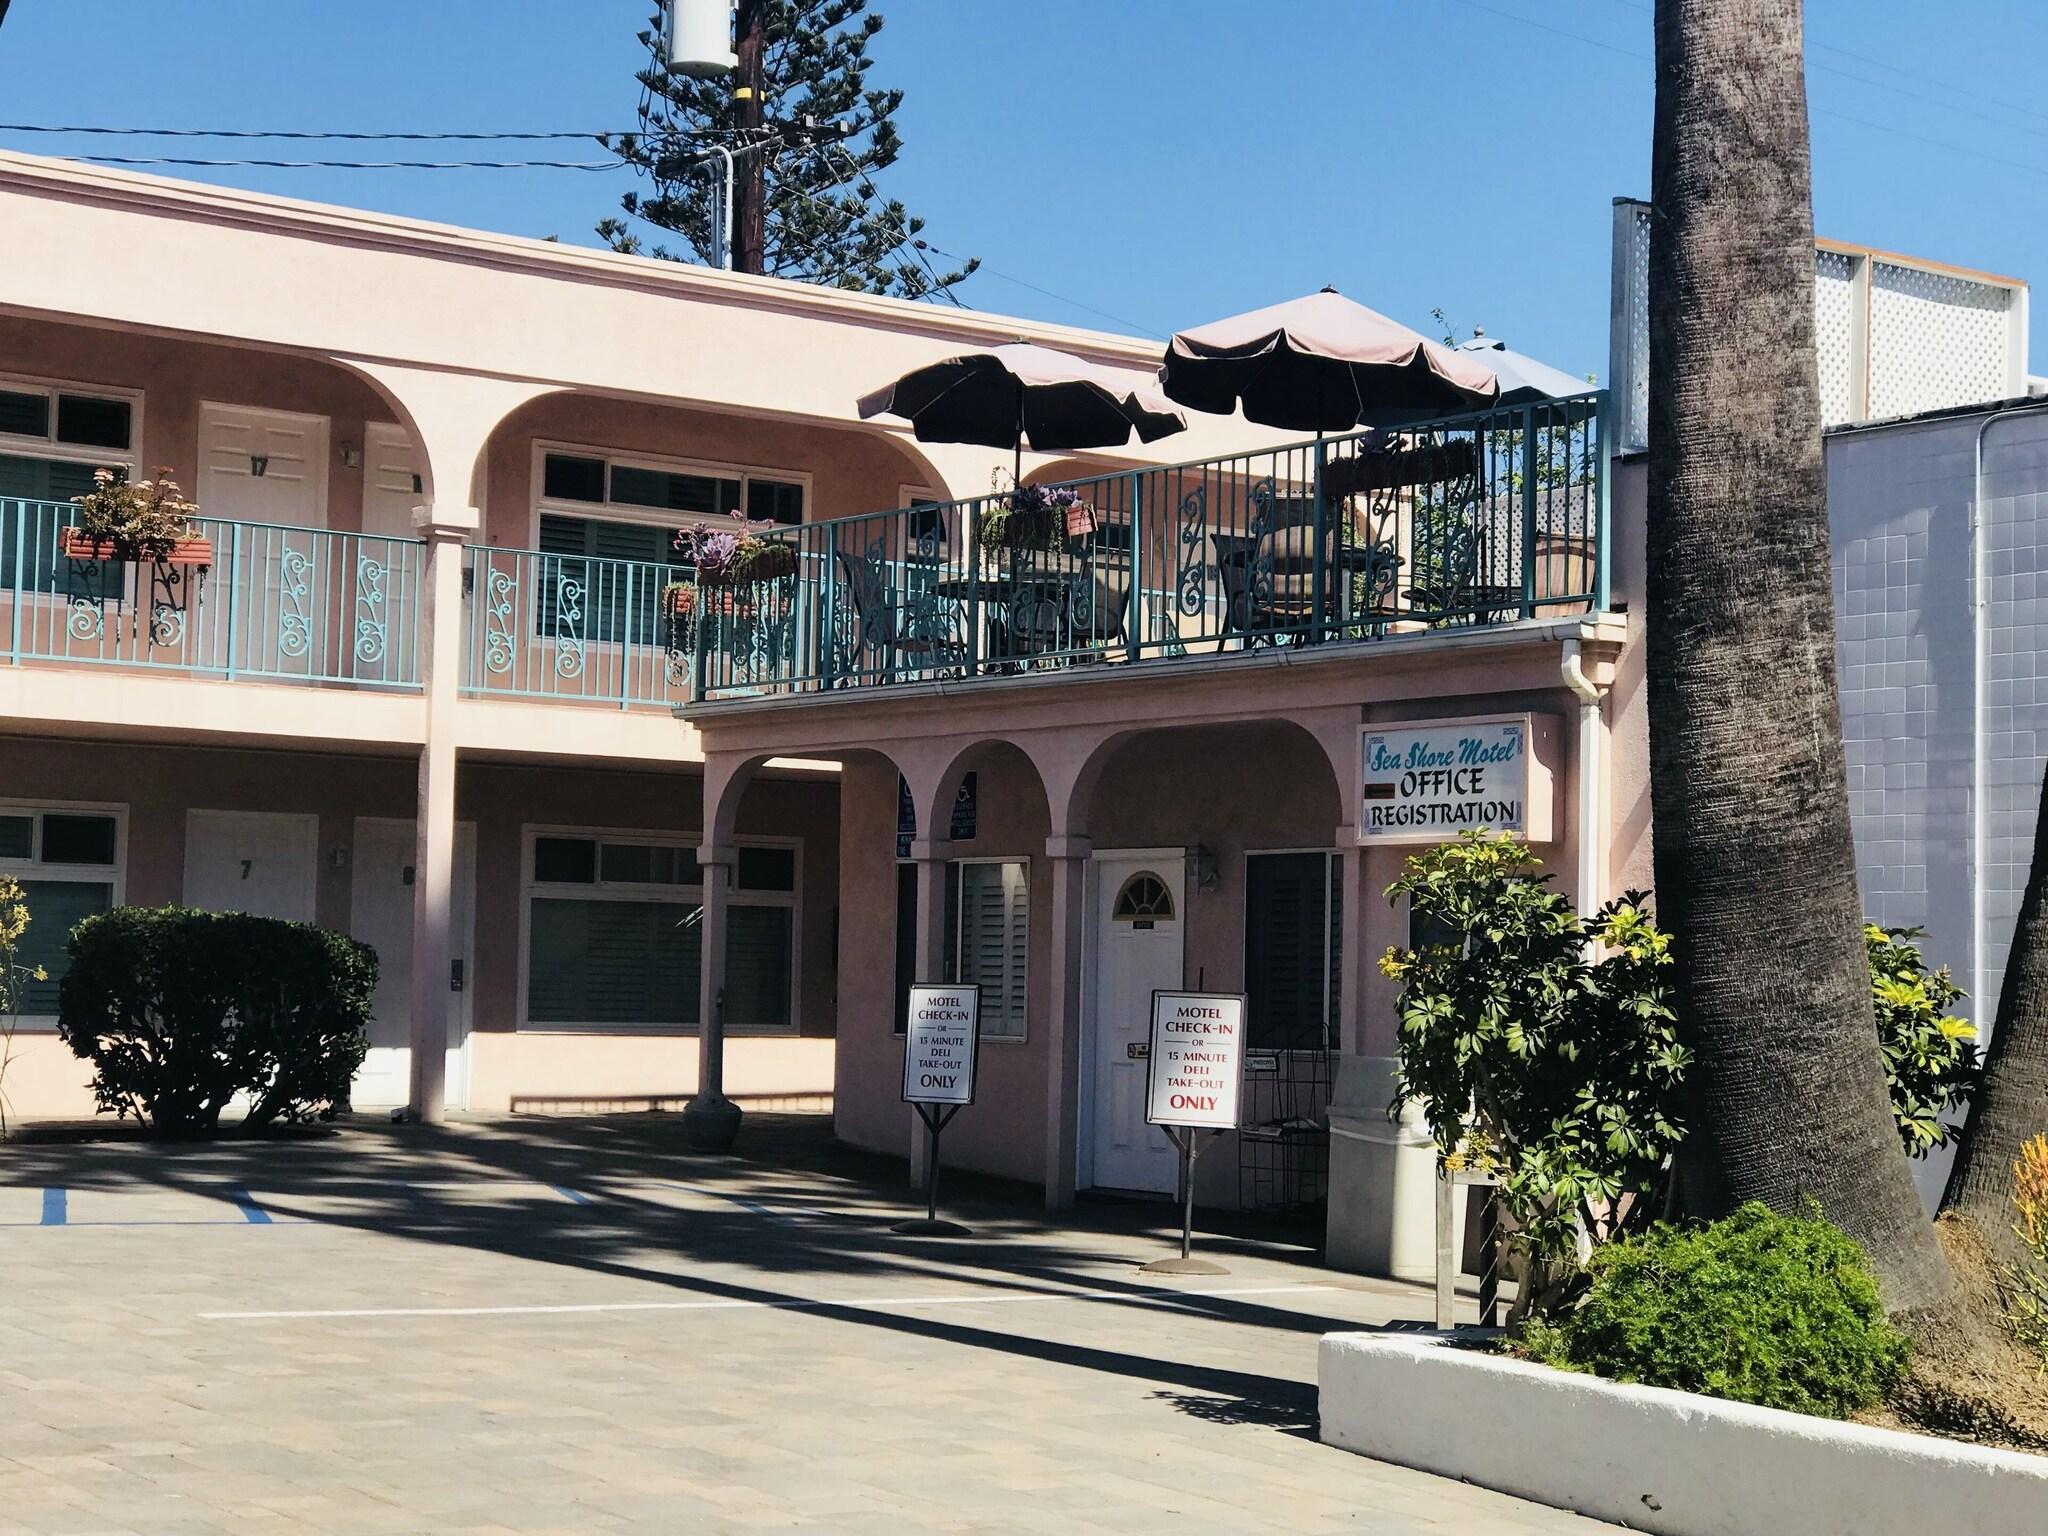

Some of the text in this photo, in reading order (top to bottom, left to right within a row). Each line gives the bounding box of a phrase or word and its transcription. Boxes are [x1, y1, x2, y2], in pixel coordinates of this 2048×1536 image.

[251, 456, 269, 477] 17
[1371, 737, 1516, 771] Sea Shore Motel
[1400, 768, 1486, 797] OFFICE
[1371, 800, 1515, 826] REGISTRATION
[241, 860, 252, 880] 7
[927, 997, 961, 1007] MOTEL
[918, 1010, 969, 1021] CHECK-IN
[1176, 1007, 1222, 1019] MOTEL
[1165, 1021, 1233, 1034] CHECK-IN
[920, 1036, 964, 1046] 15 MINUTE
[931, 1048, 951, 1057] DELI
[1168, 1051, 1228, 1063] 15 MINUTE
[918, 1060, 962, 1069] TAKE-OUT
[1183, 1065, 1209, 1074] DELI
[920, 1074, 957, 1088] ONLY
[1167, 1078, 1224, 1089] TAKE-OUT
[1170, 1094, 1218, 1111] ONLY
